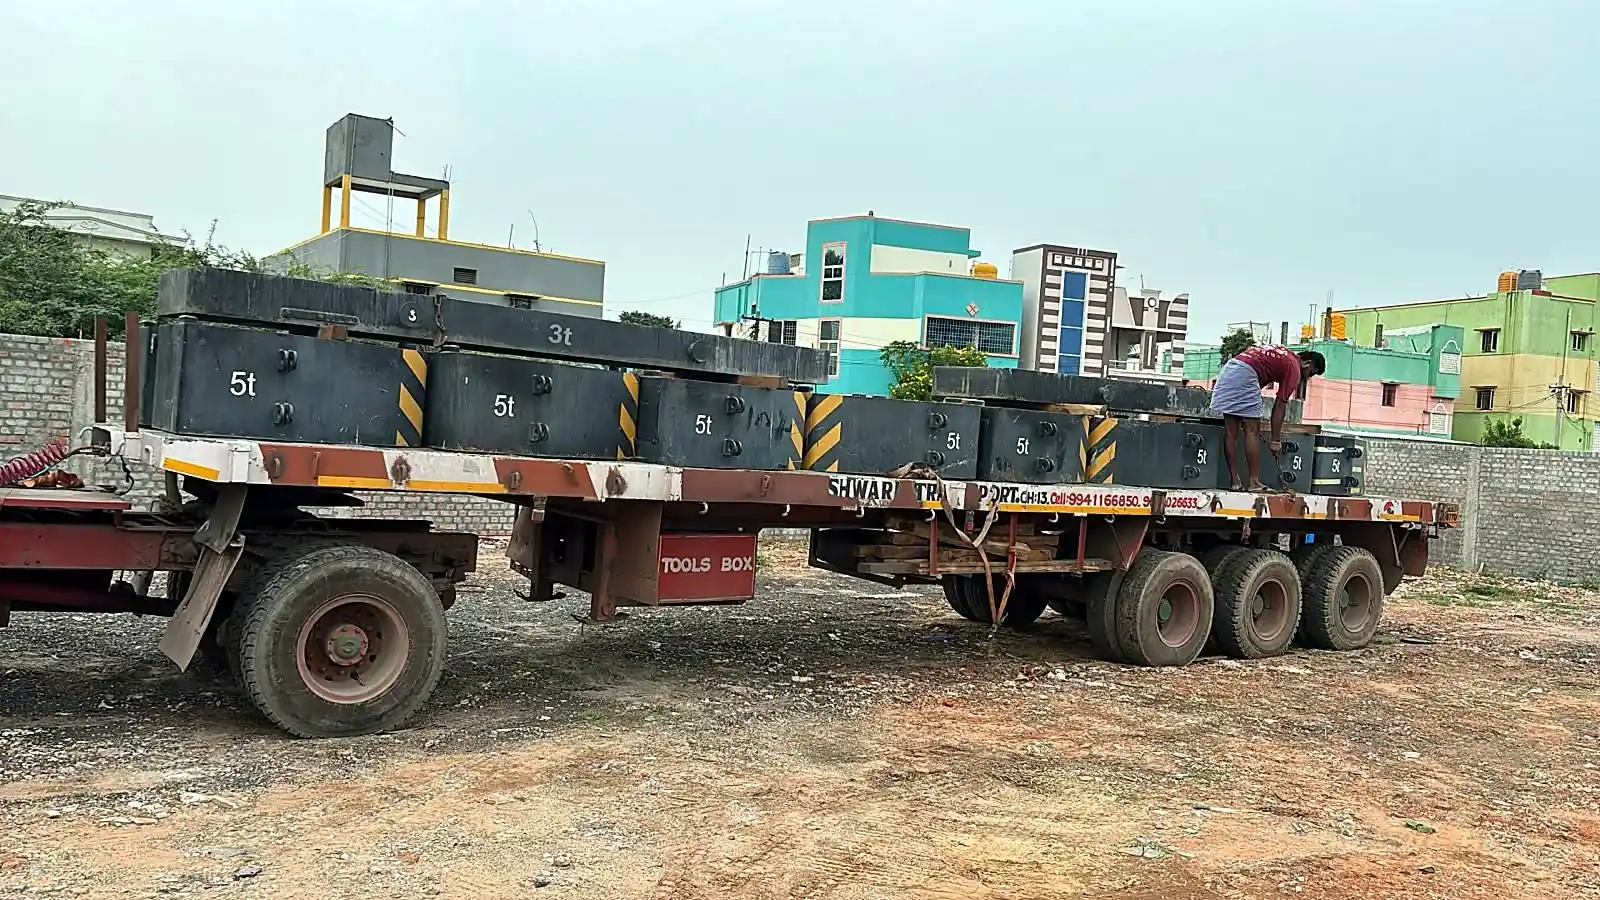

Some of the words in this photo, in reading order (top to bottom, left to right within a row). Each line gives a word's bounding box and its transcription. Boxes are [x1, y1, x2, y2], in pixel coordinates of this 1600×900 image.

[548, 324, 573, 346] 3t
[229, 371, 257, 397] 5t
[493, 394, 515, 418] 5t
[695, 414, 713, 435] 5t
[946, 432, 961, 450] 5t
[1016, 437, 1030, 455] 5t
[1196, 449, 1208, 465] 5t
[1292, 455, 1302, 471] 5t
[1331, 458, 1341, 473] 5t
[662, 557, 711, 573] TOOLS
[721, 557, 753, 572] BOX
